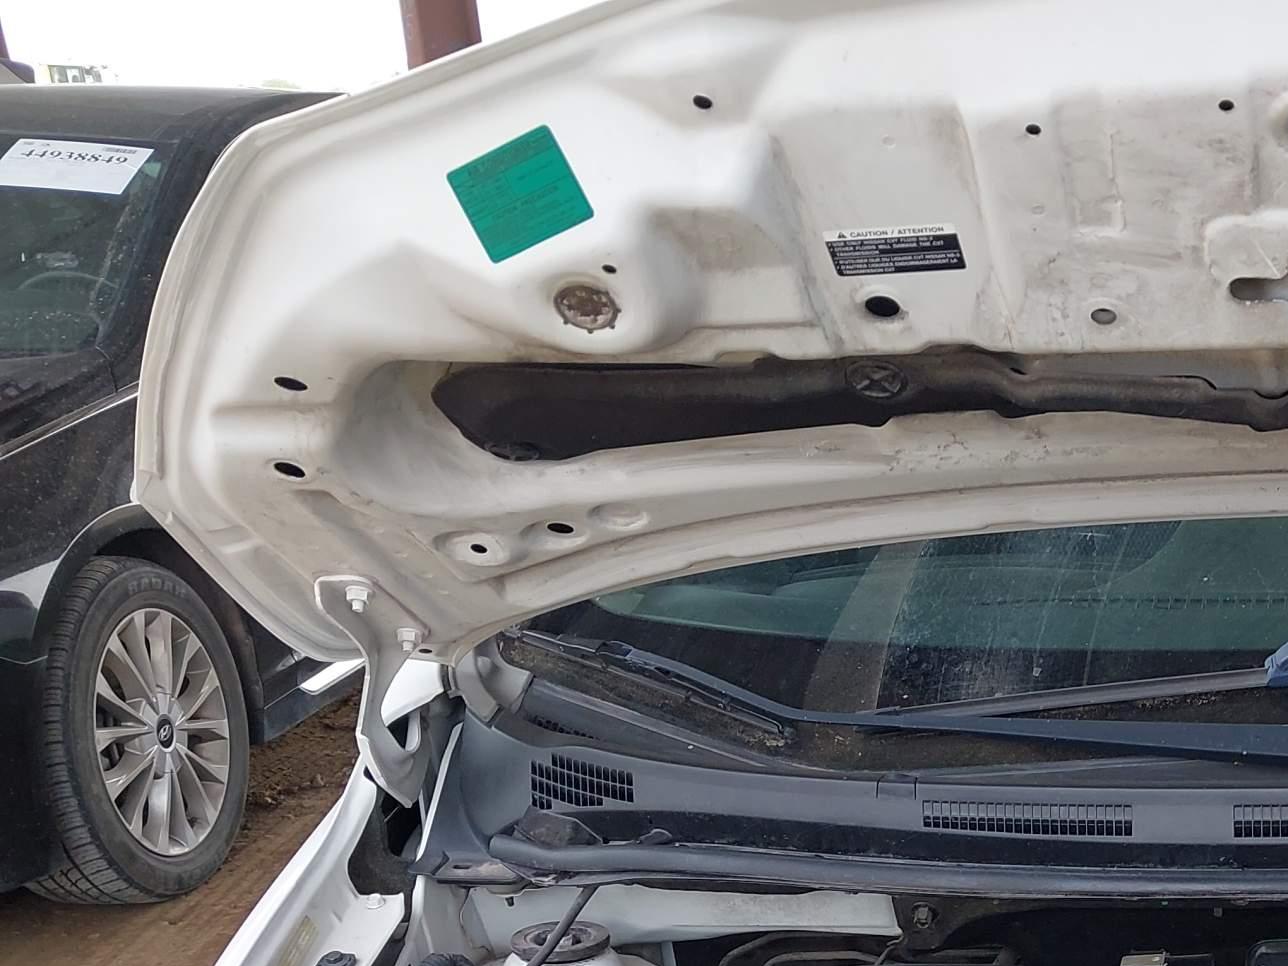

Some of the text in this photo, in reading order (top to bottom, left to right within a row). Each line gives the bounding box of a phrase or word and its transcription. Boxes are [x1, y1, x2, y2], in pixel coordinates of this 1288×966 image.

[21, 149, 129, 164] 44938849
[849, 230, 889, 238] CAUTION
[897, 226, 945, 235] ATTENTION
